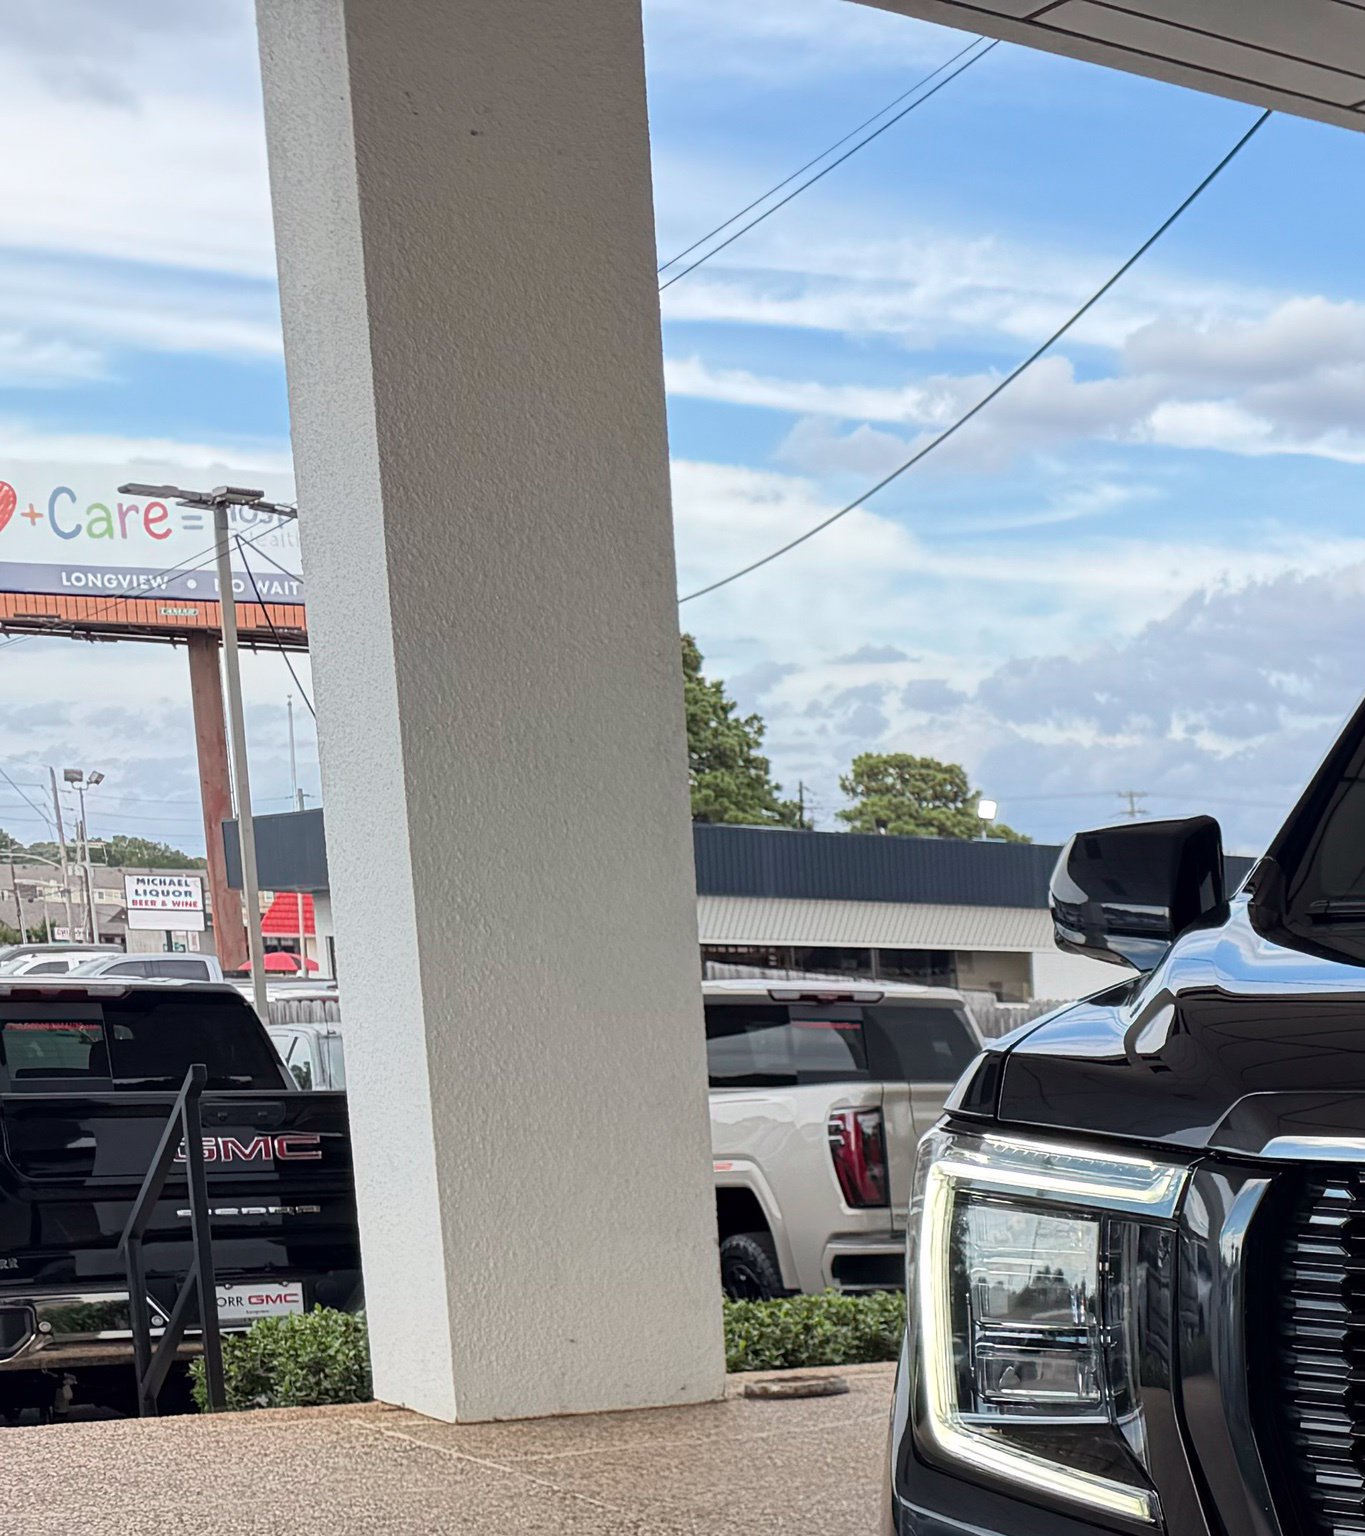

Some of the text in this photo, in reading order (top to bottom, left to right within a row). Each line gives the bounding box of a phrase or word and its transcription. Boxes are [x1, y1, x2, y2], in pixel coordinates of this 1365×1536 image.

[61, 571, 169, 590] LONGVIEW
[136, 877, 190, 887] MICHAEL
[134, 889, 192, 898] LIQUOR
[132, 899, 157, 907] BEER
[172, 900, 198, 908] WINE
[248, 1293, 299, 1305] GMC
